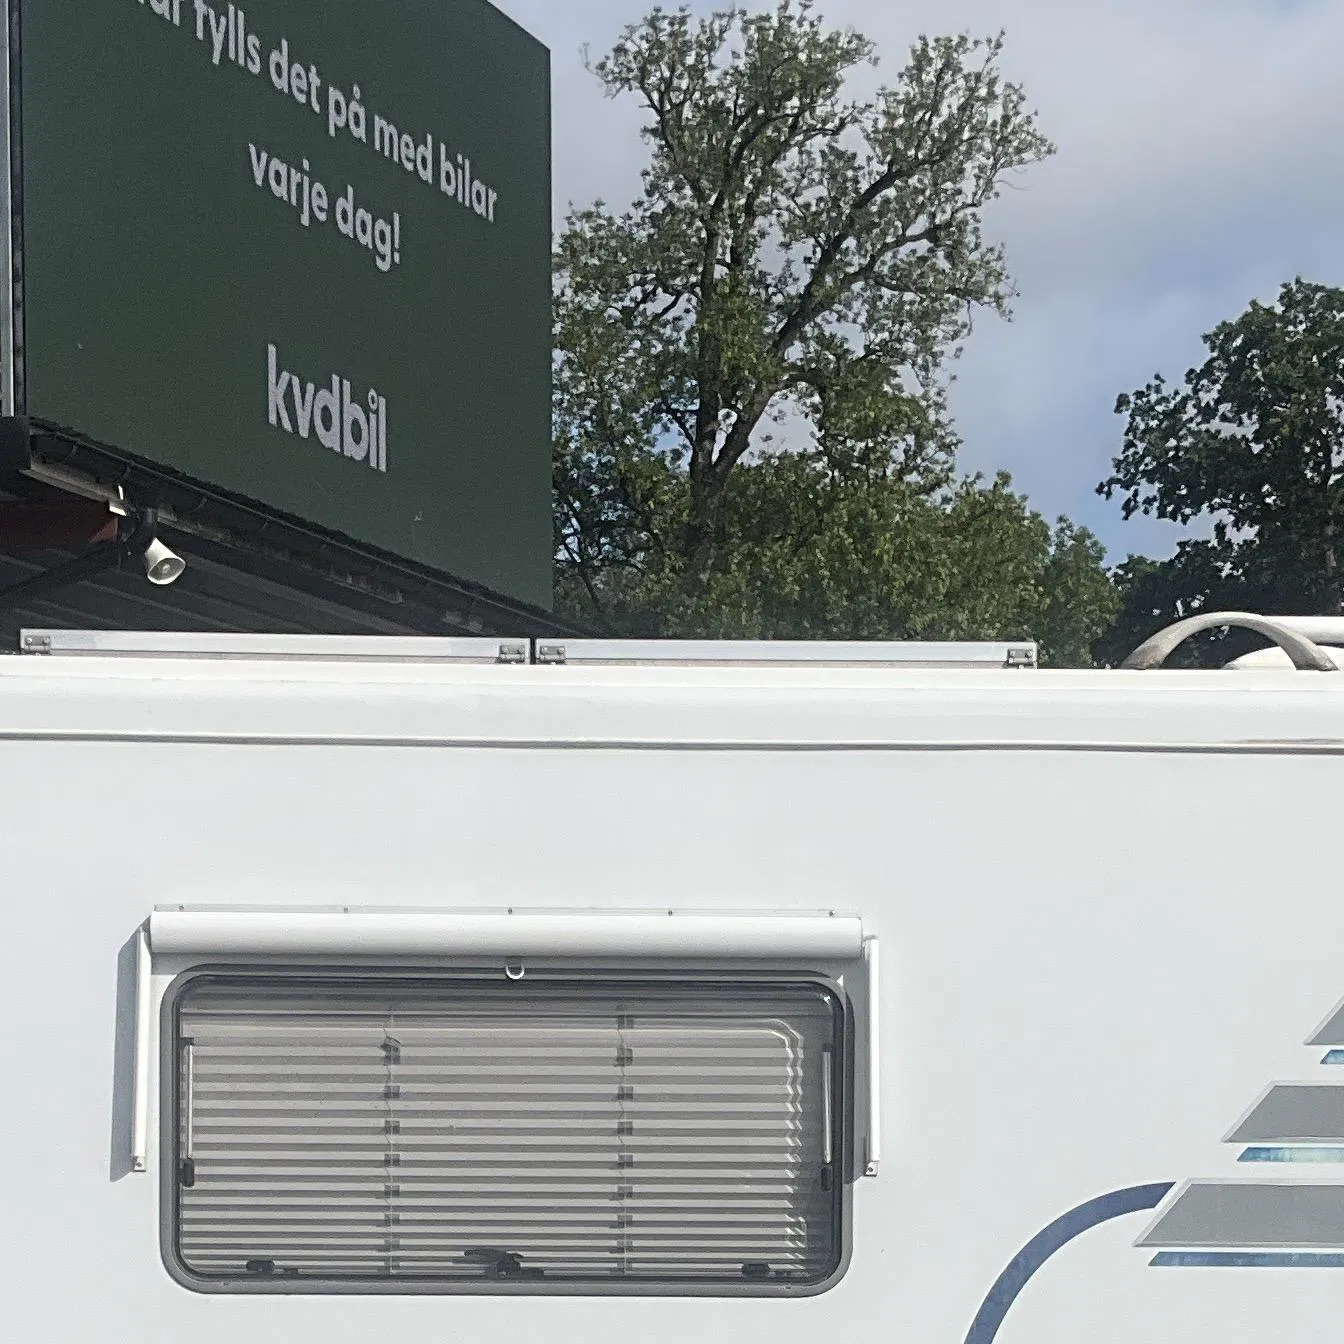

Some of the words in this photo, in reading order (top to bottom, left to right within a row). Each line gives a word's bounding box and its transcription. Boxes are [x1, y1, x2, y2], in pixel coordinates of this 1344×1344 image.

[193, 0, 262, 75] fylls
[268, 38, 321, 114] det
[328, 84, 367, 144] på
[374, 114, 434, 185] med
[440, 143, 499, 223] bilar
[248, 143, 329, 227] varje
[335, 185, 401, 273] dag!
[267, 343, 388, 473] kvdbil
